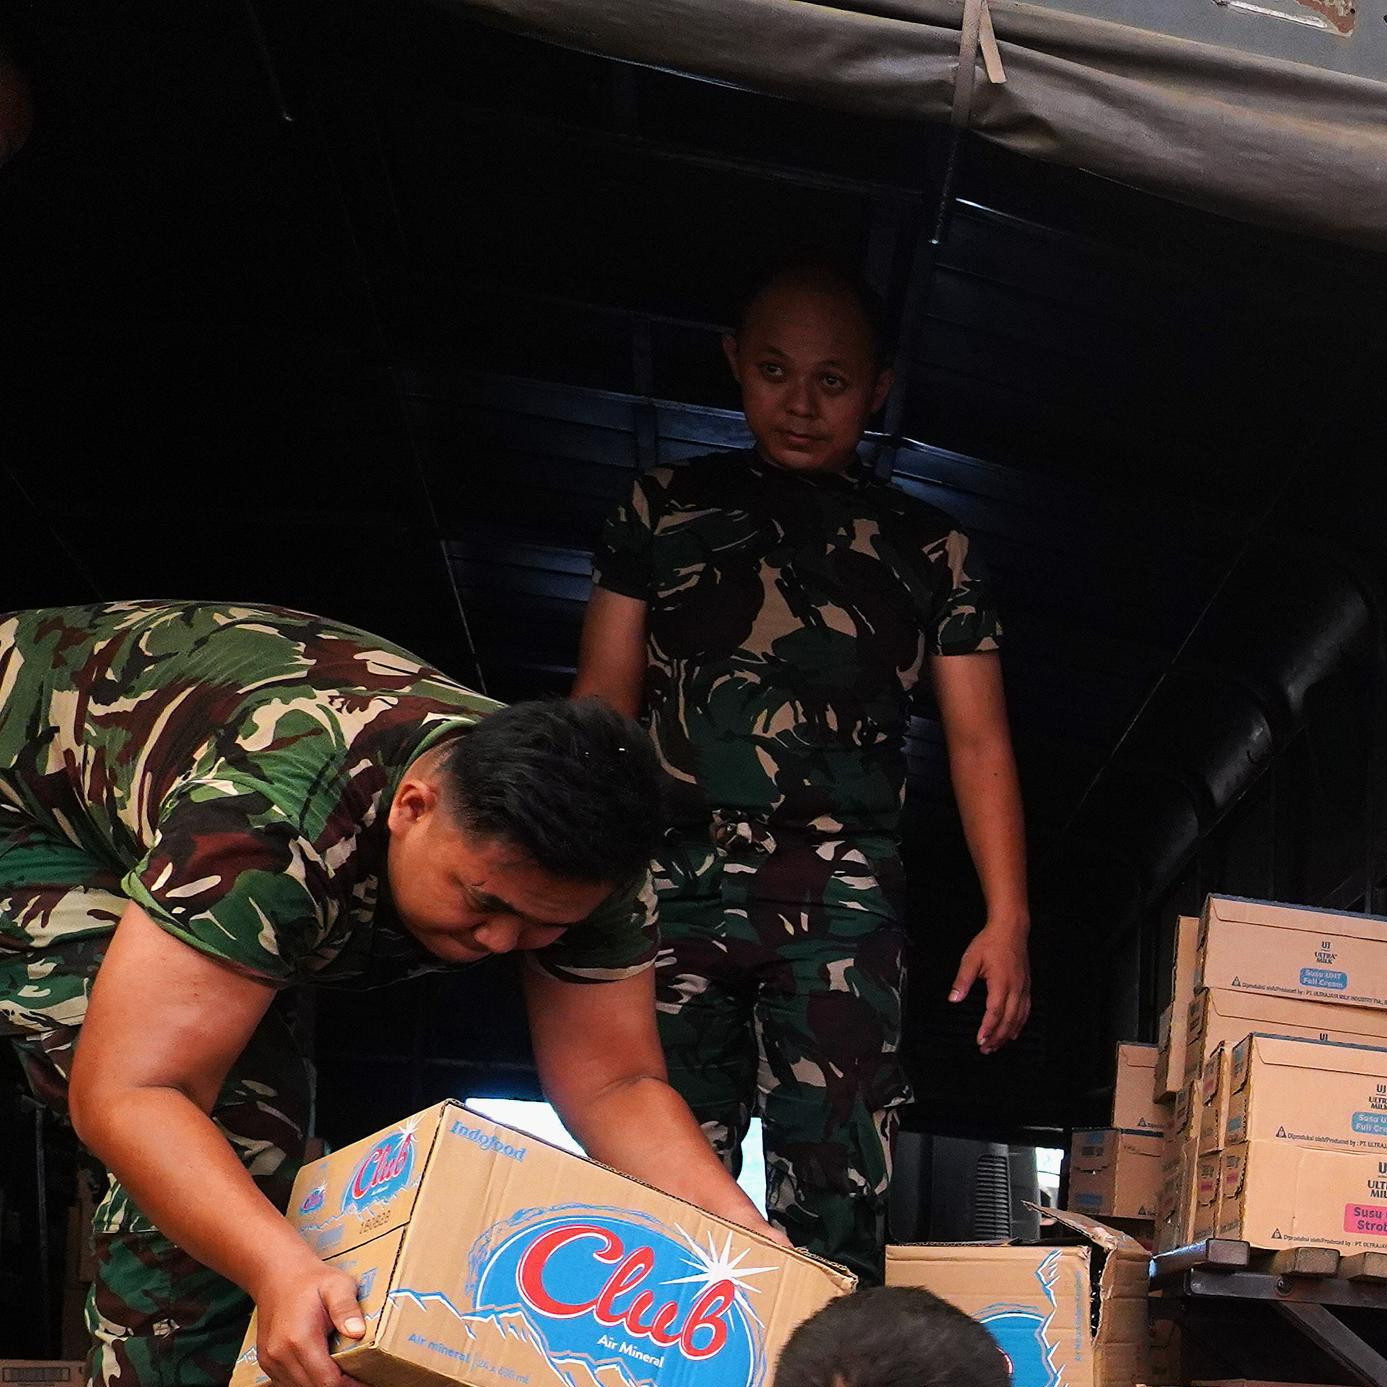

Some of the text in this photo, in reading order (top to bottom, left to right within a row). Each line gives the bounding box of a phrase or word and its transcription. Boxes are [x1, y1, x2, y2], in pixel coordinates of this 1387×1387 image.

[450, 1120, 527, 1162] Indofood
[352, 1133, 412, 1199] Club
[1353, 1206, 1383, 1219] Susu
[516, 1224, 735, 1361] Club
[427, 1340, 470, 1363] mineral
[597, 1333, 664, 1368] Air Mineral
